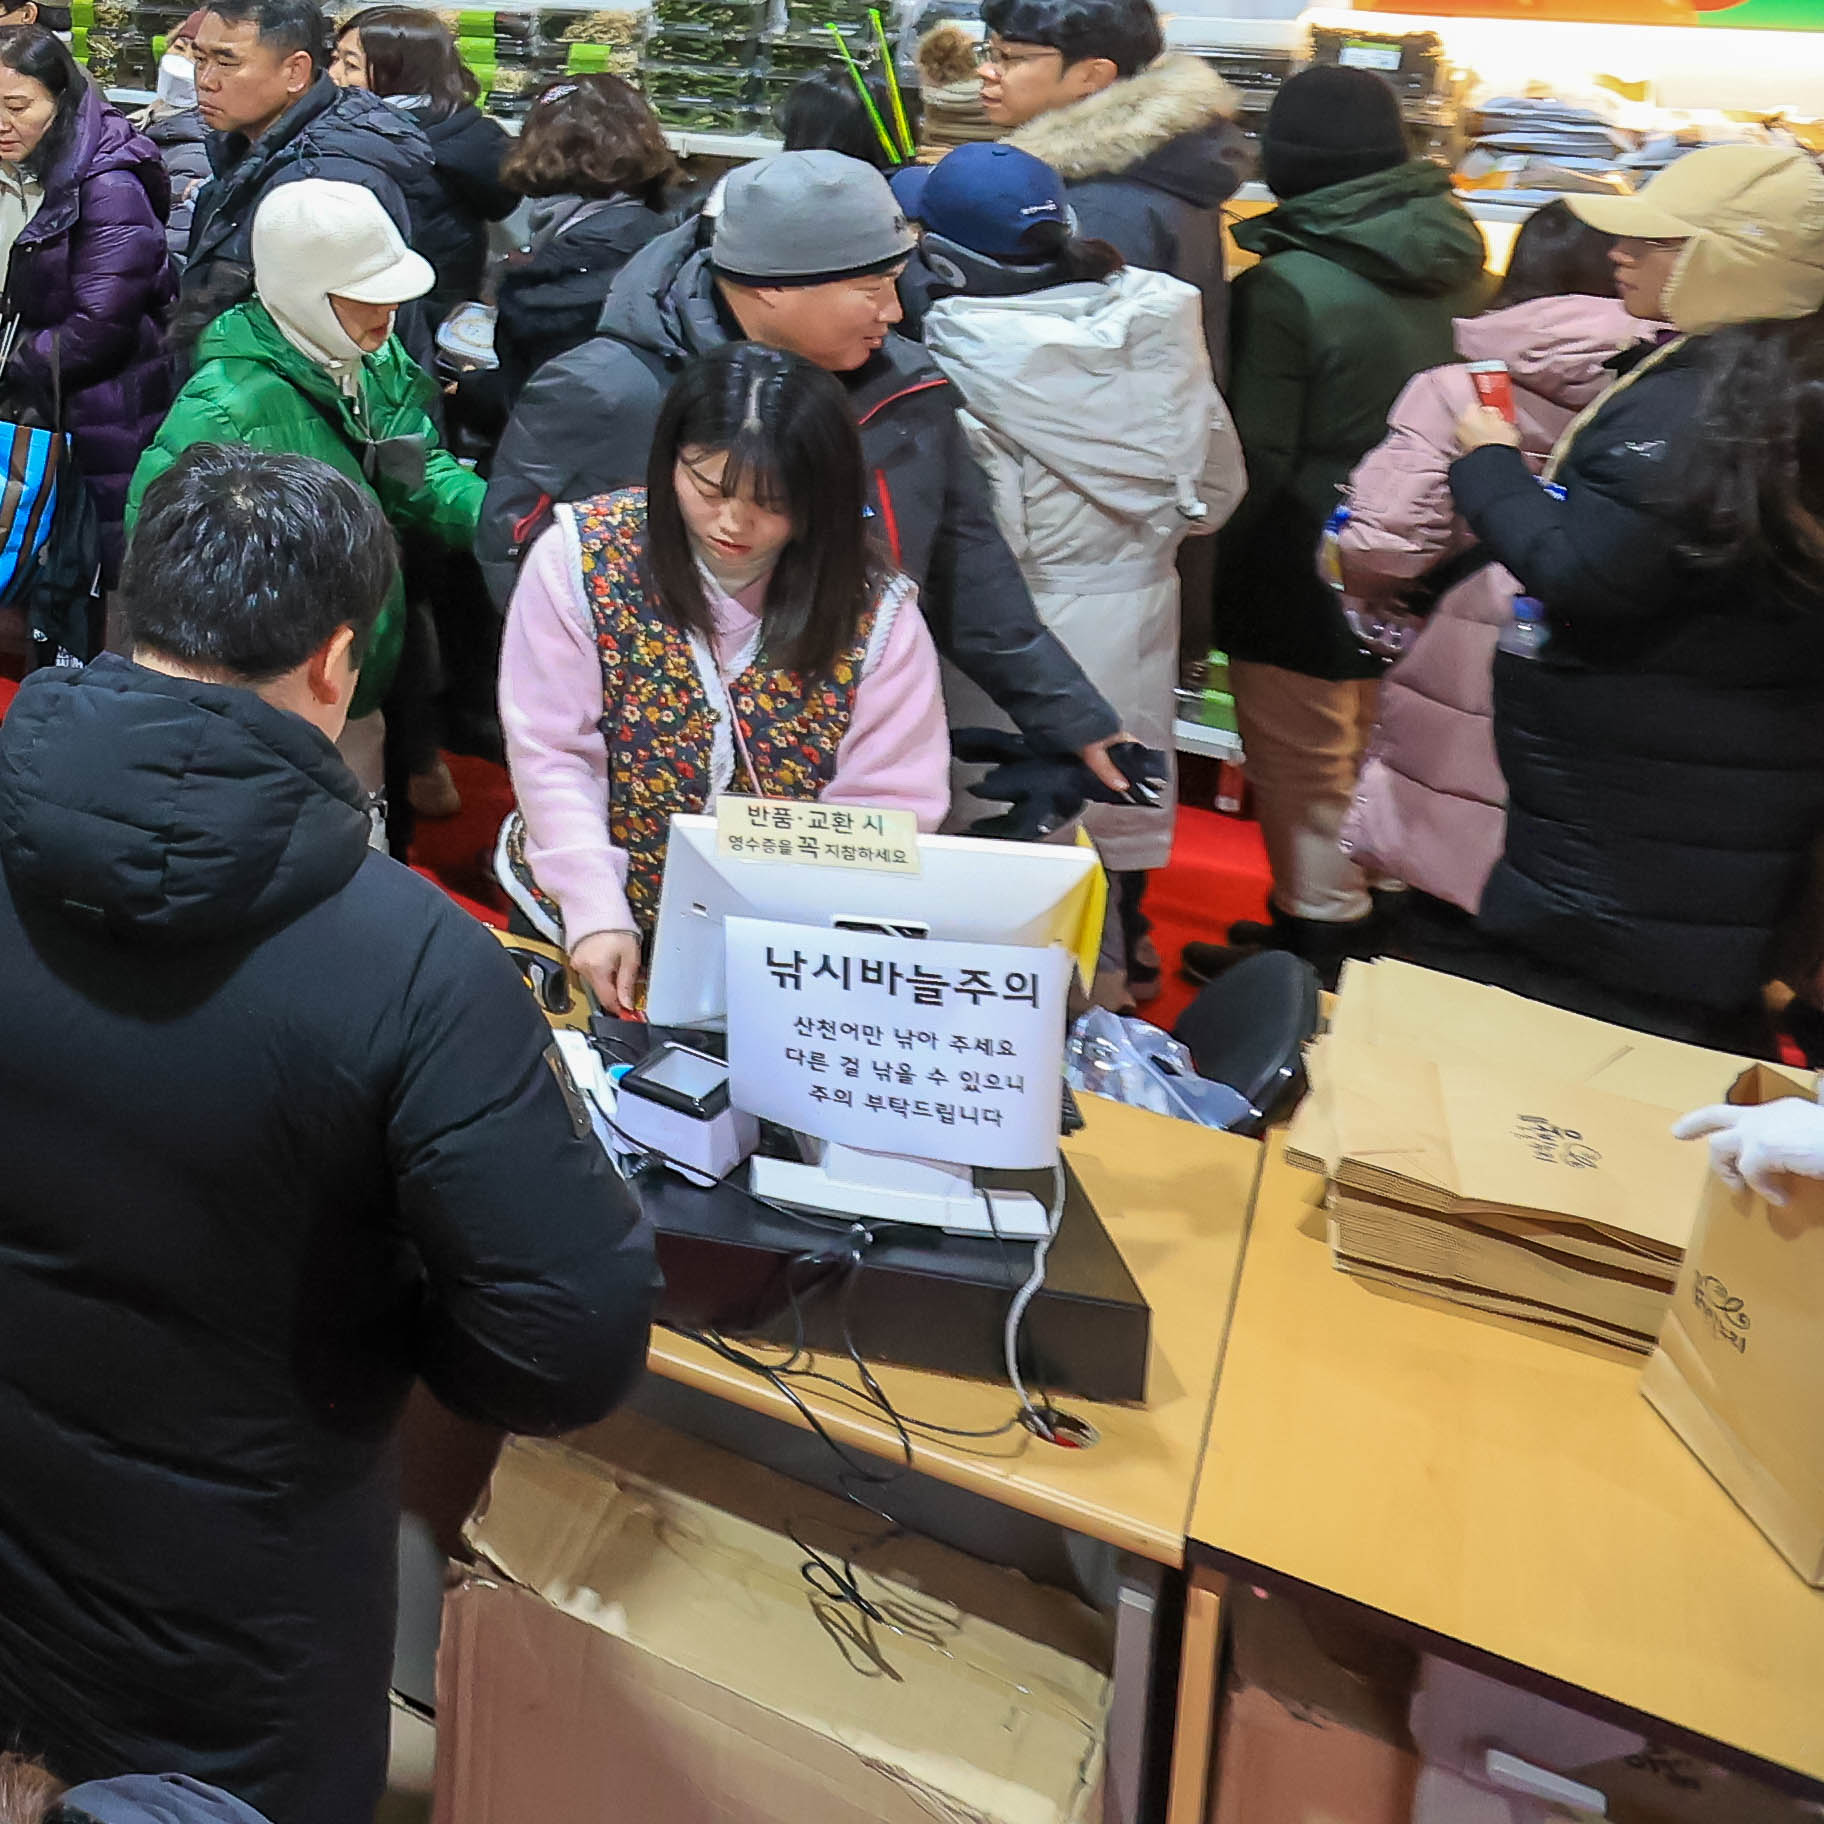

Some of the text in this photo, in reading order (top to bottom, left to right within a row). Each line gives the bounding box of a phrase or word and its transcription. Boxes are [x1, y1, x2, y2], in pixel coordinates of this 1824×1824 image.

[863, 814, 884, 836] 시
[728, 835, 909, 864] 영수증을 꼭 지참하세요
[765, 946, 1040, 1009] 낚시바늘주의
[793, 1015, 1017, 1057] 산천어만 낚아 주세요
[785, 1047, 1025, 1094] 다른 걸 낚을 수 있으니
[808, 1083, 1004, 1128] 주의 부탁드립니다
